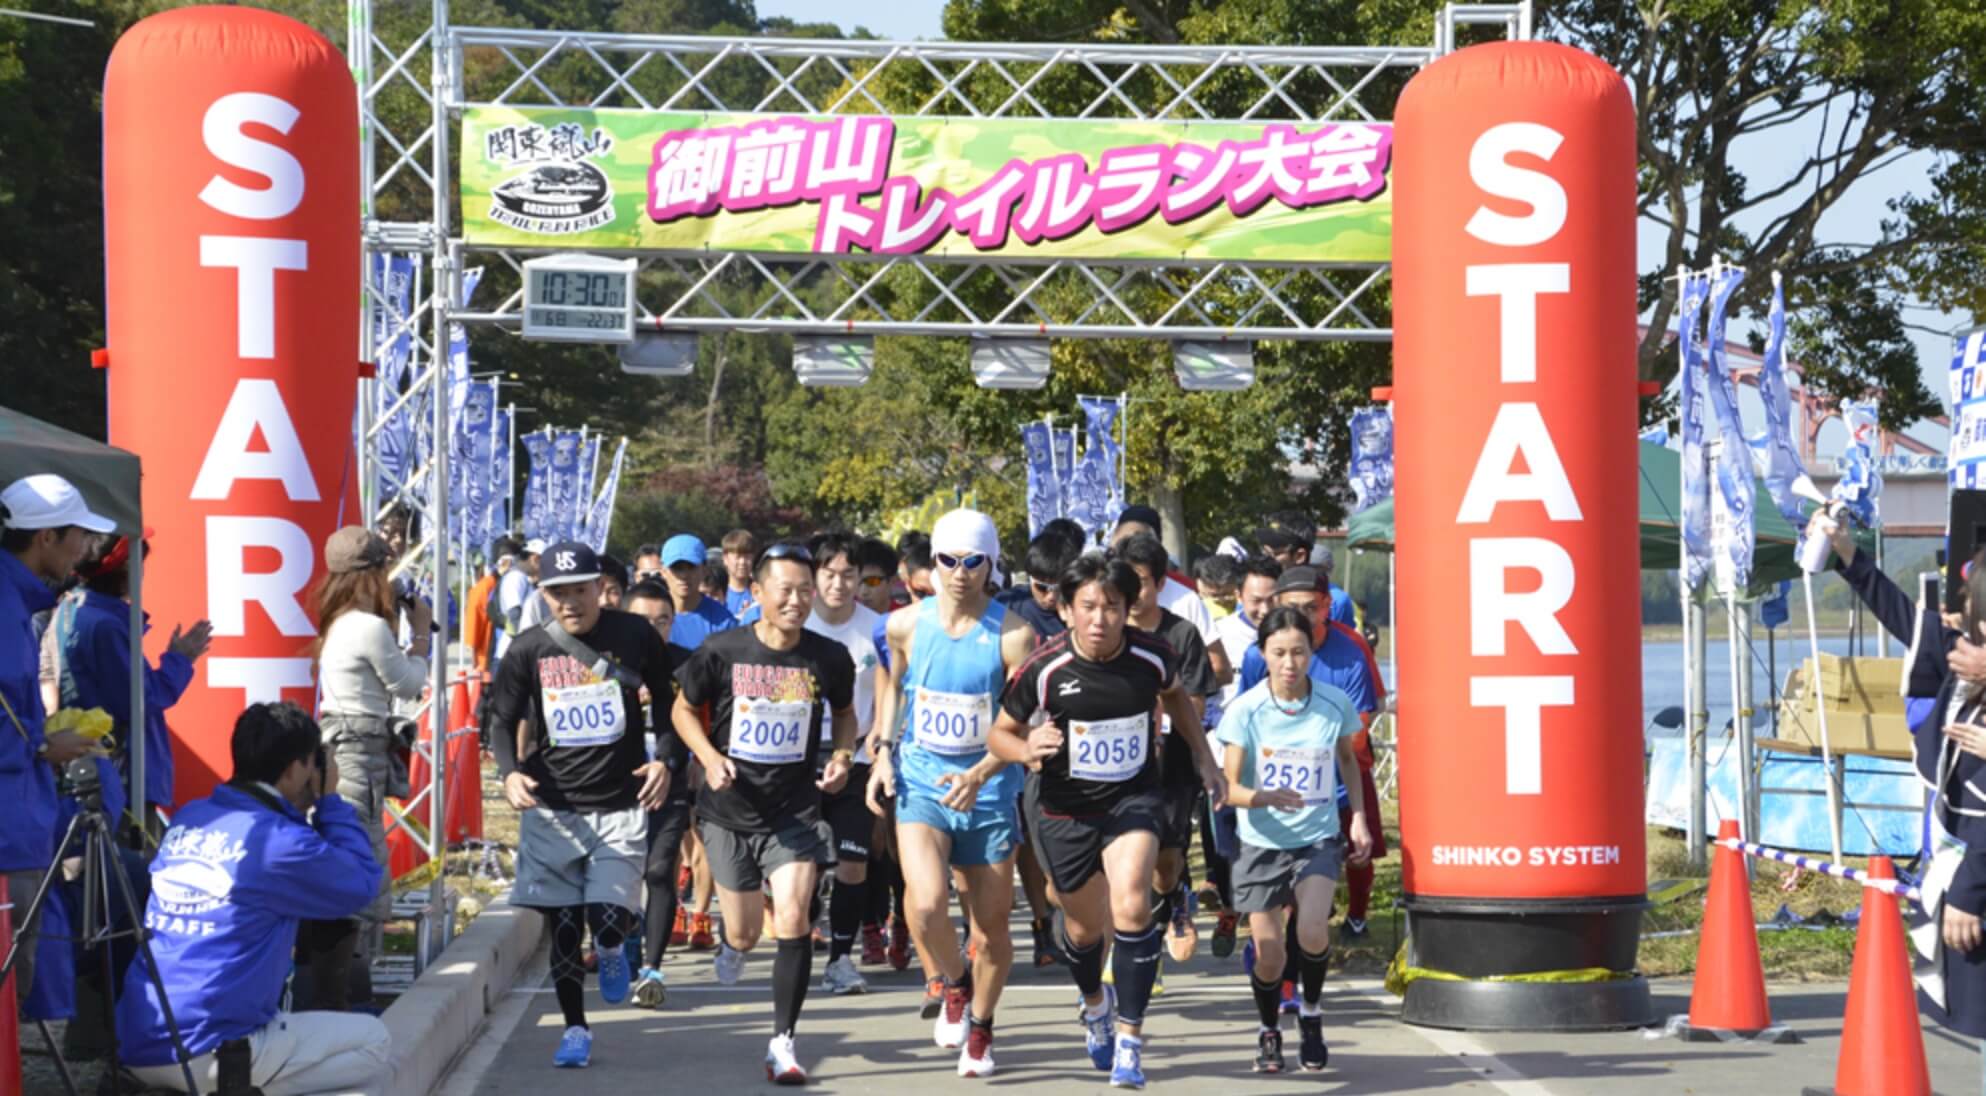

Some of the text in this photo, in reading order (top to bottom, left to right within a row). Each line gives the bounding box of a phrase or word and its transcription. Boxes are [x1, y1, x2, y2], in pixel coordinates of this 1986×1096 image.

[653, 116, 882, 209] 御前山
[819, 124, 1386, 254] トレイルラン大会
[542, 272, 609, 306] 10:30
[189, 91, 321, 709] START
[1455, 121, 1584, 796] START
[553, 700, 617, 732] 2005
[920, 708, 980, 738] 2001
[739, 719, 800, 747] 2004
[1078, 735, 1142, 766] 2058
[1262, 762, 1323, 792] 2521
[1431, 845, 1620, 867] SHINKO SYSTEM
[144, 911, 216, 936] STAFF
